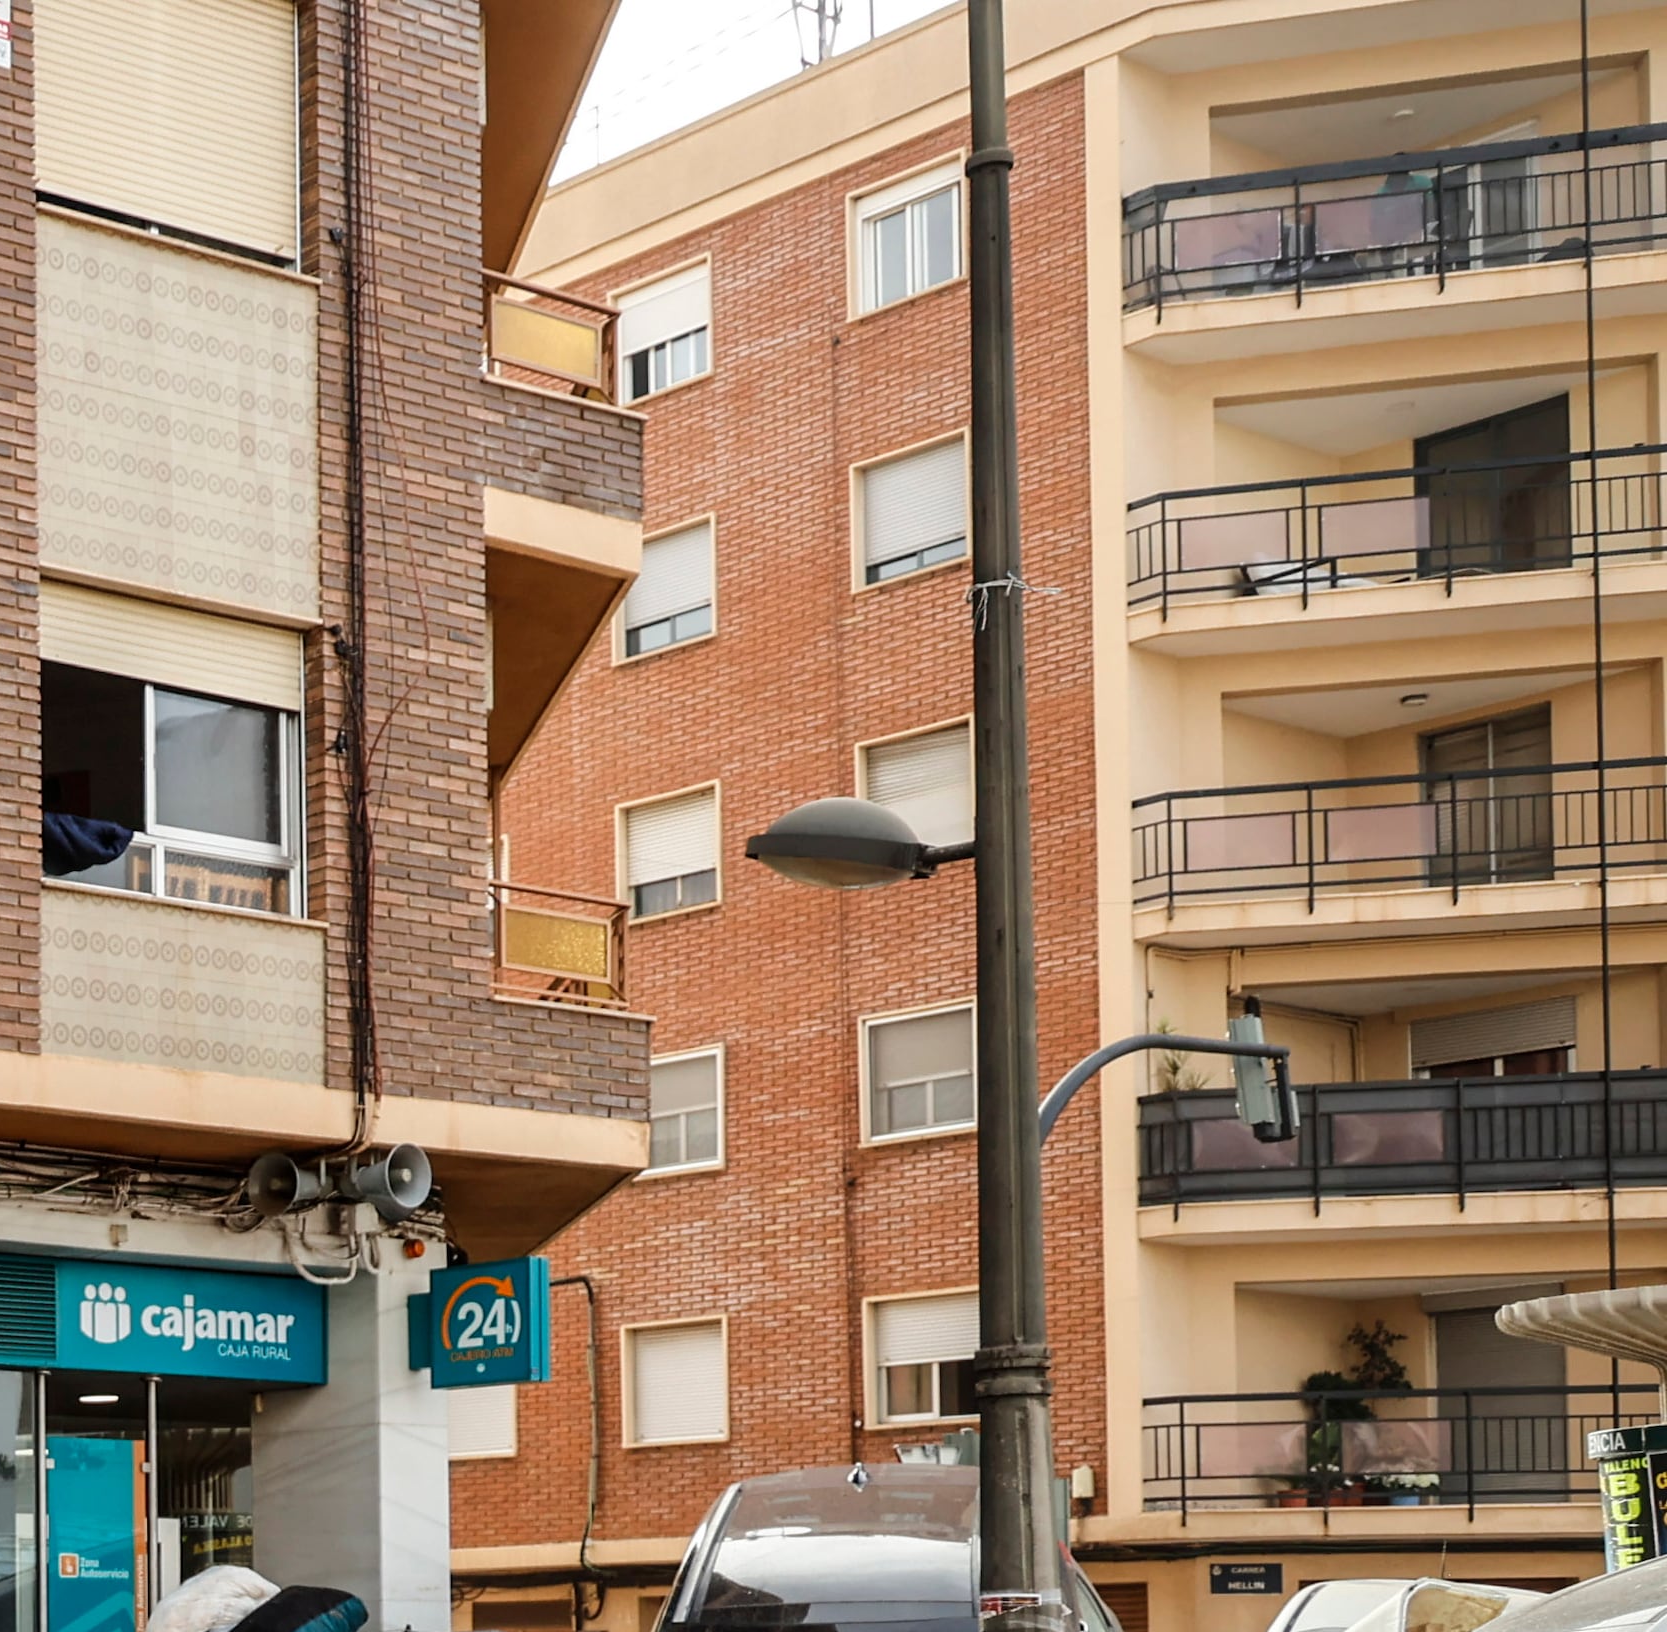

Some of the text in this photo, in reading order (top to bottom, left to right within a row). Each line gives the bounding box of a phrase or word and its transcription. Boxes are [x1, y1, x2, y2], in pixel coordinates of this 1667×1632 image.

[140, 1293, 295, 1352] cajamar
[218, 1343, 291, 1361] CAJA RURAL
[80, 1557, 100, 1568] Zona
[80, 1569, 129, 1579] Autoservicio
[137, 1554, 148, 1609] Autoservicio
